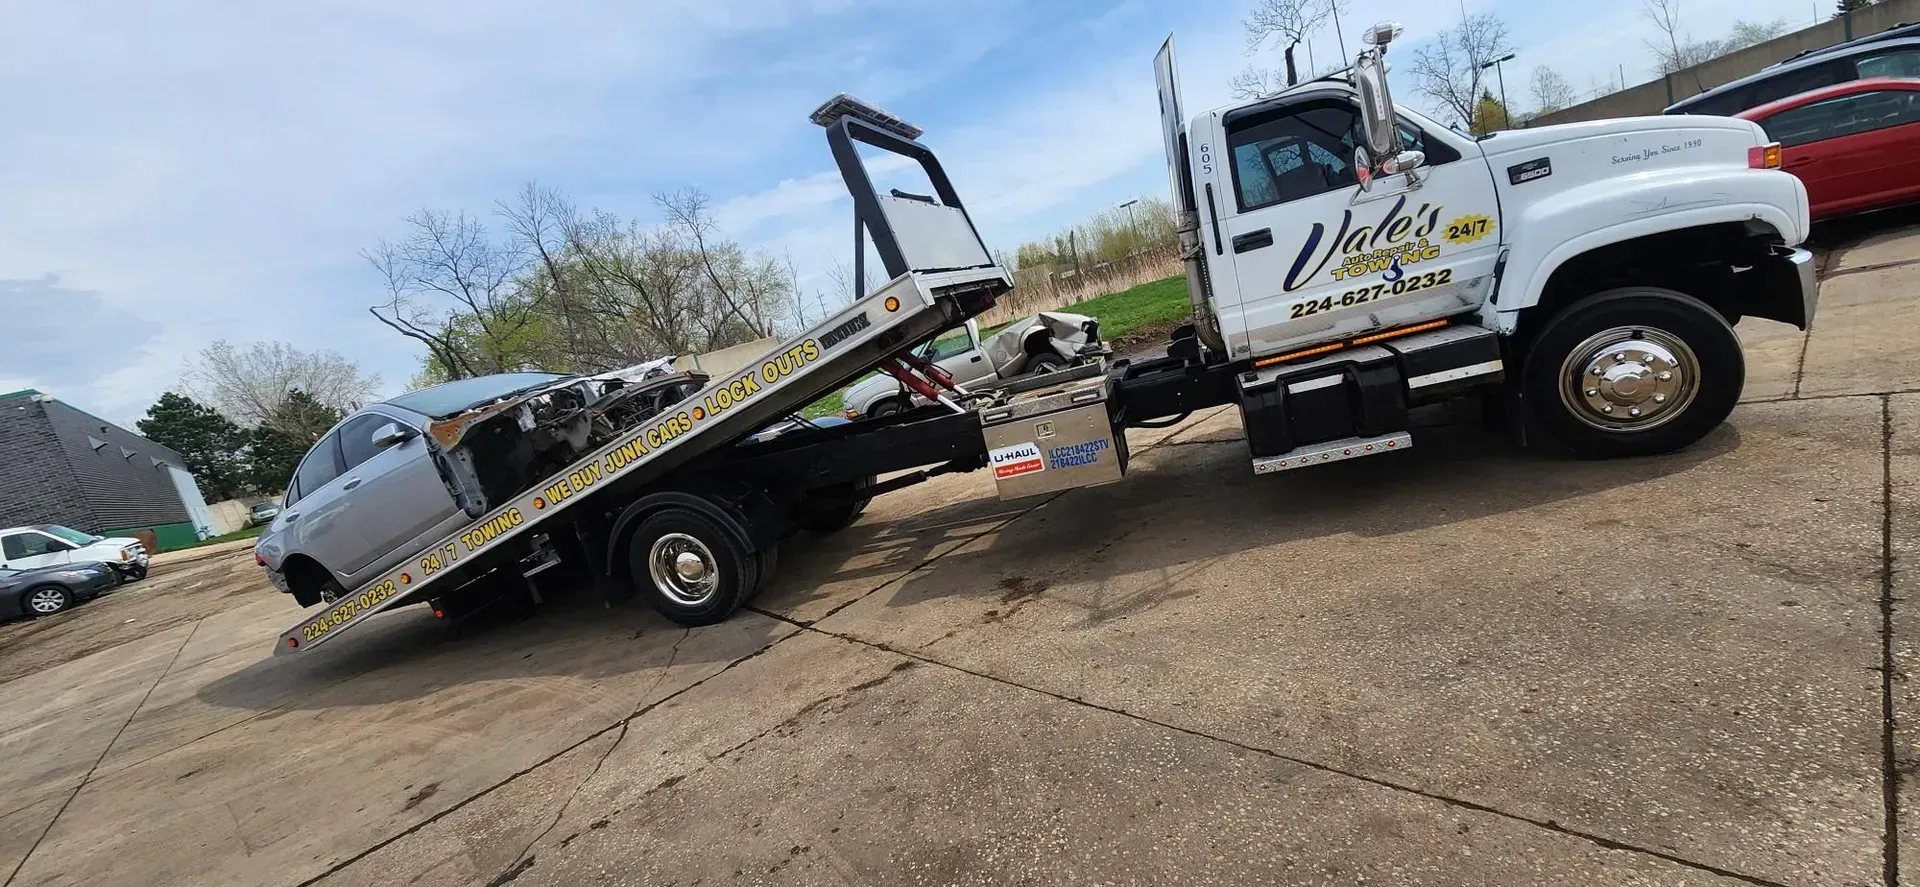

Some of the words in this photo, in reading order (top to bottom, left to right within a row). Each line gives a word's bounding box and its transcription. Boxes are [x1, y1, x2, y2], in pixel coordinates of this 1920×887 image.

[1200, 143, 1212, 175] 605
[1643, 148, 1659, 160] You
[1661, 143, 1681, 154] Since
[1283, 194, 1444, 292] Vale's
[1448, 218, 1488, 240] 24/7
[1342, 253, 1372, 267] Auto
[1373, 241, 1416, 259] Repair
[1418, 238, 1430, 249] &
[1290, 268, 1452, 319] 224-627-0232
[994, 447, 1037, 463] U-HAUL
[302, 579, 397, 643] 224-627-0232
[461, 507, 524, 552] TOWING
[544, 479, 573, 506] WE
[568, 460, 603, 493] BUY
[604, 435, 650, 474] JUNK
[646, 411, 693, 449] CARS
[704, 371, 762, 417] LOCK
[761, 338, 820, 384] OUTS
